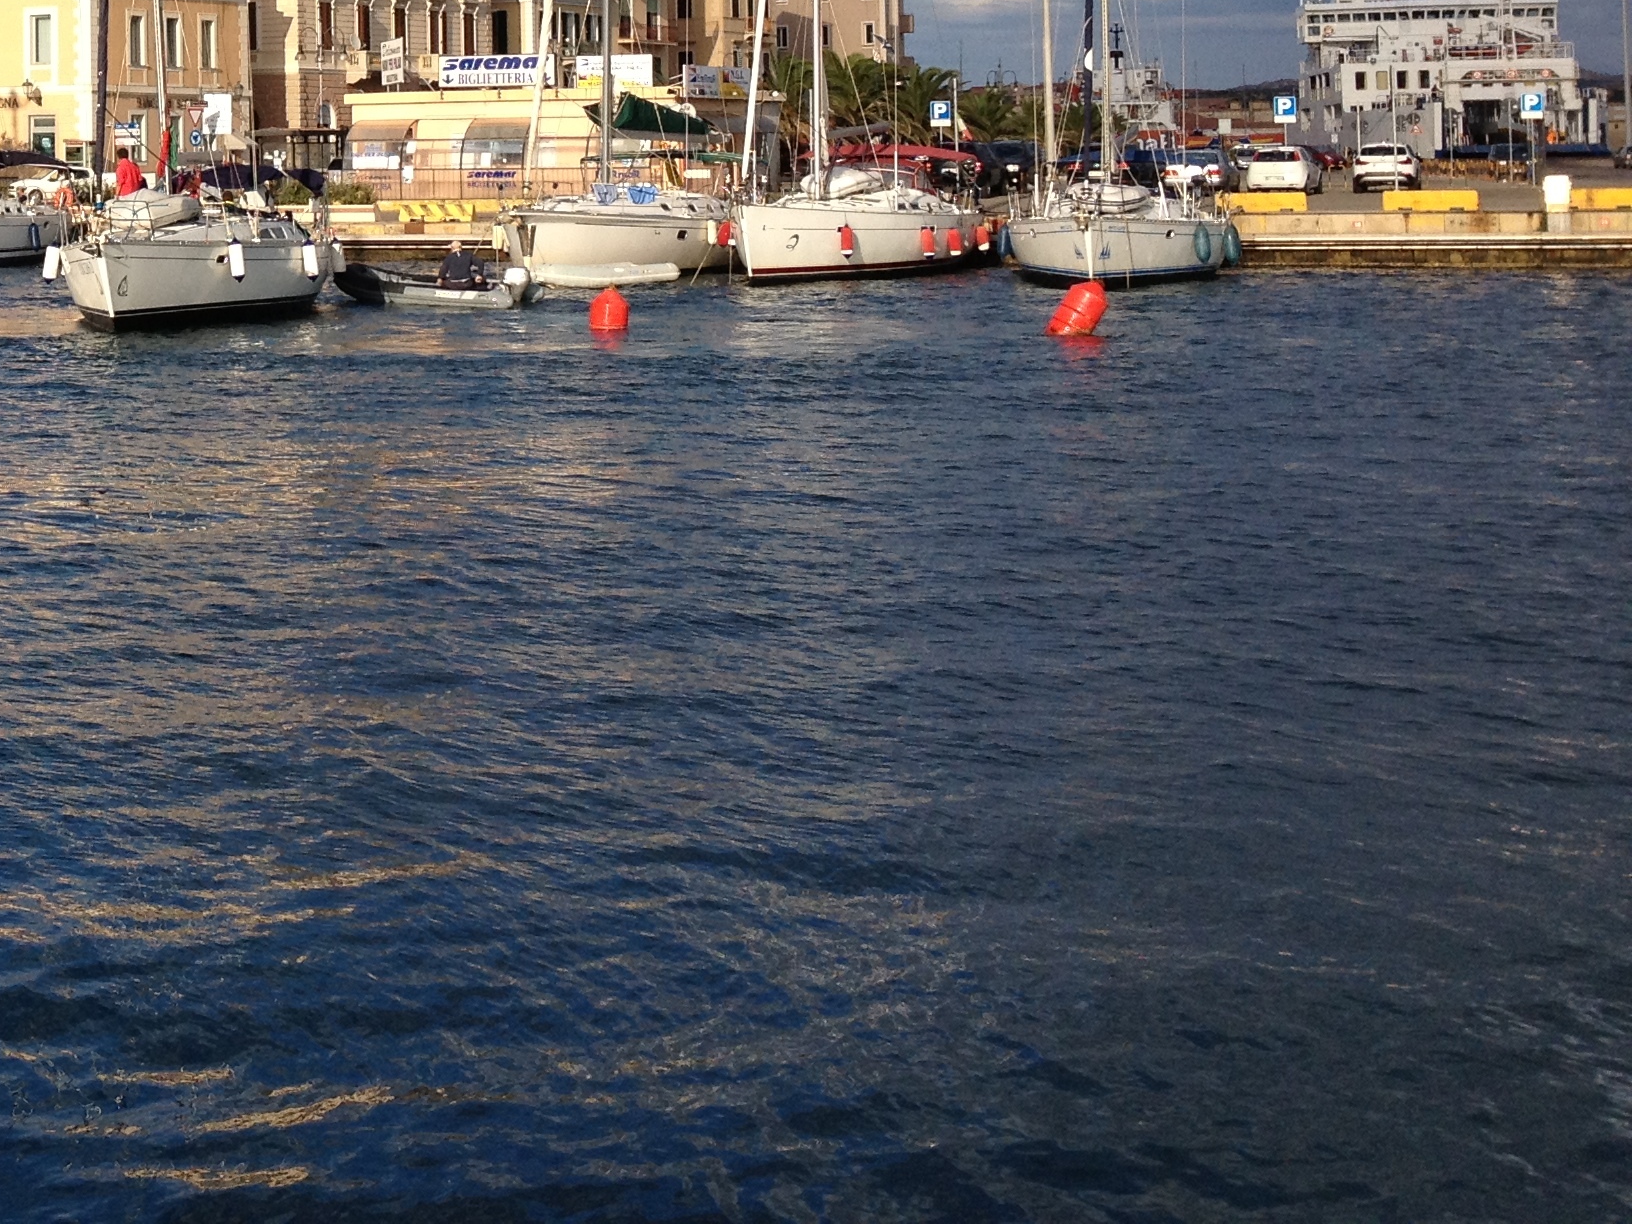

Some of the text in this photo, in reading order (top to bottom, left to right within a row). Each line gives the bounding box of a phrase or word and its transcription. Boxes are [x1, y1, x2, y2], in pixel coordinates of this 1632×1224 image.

[458, 73, 534, 85] BIGLIETTERIA
[1277, 98, 1292, 115] P
[1524, 94, 1539, 111] P
[933, 103, 947, 119] P
